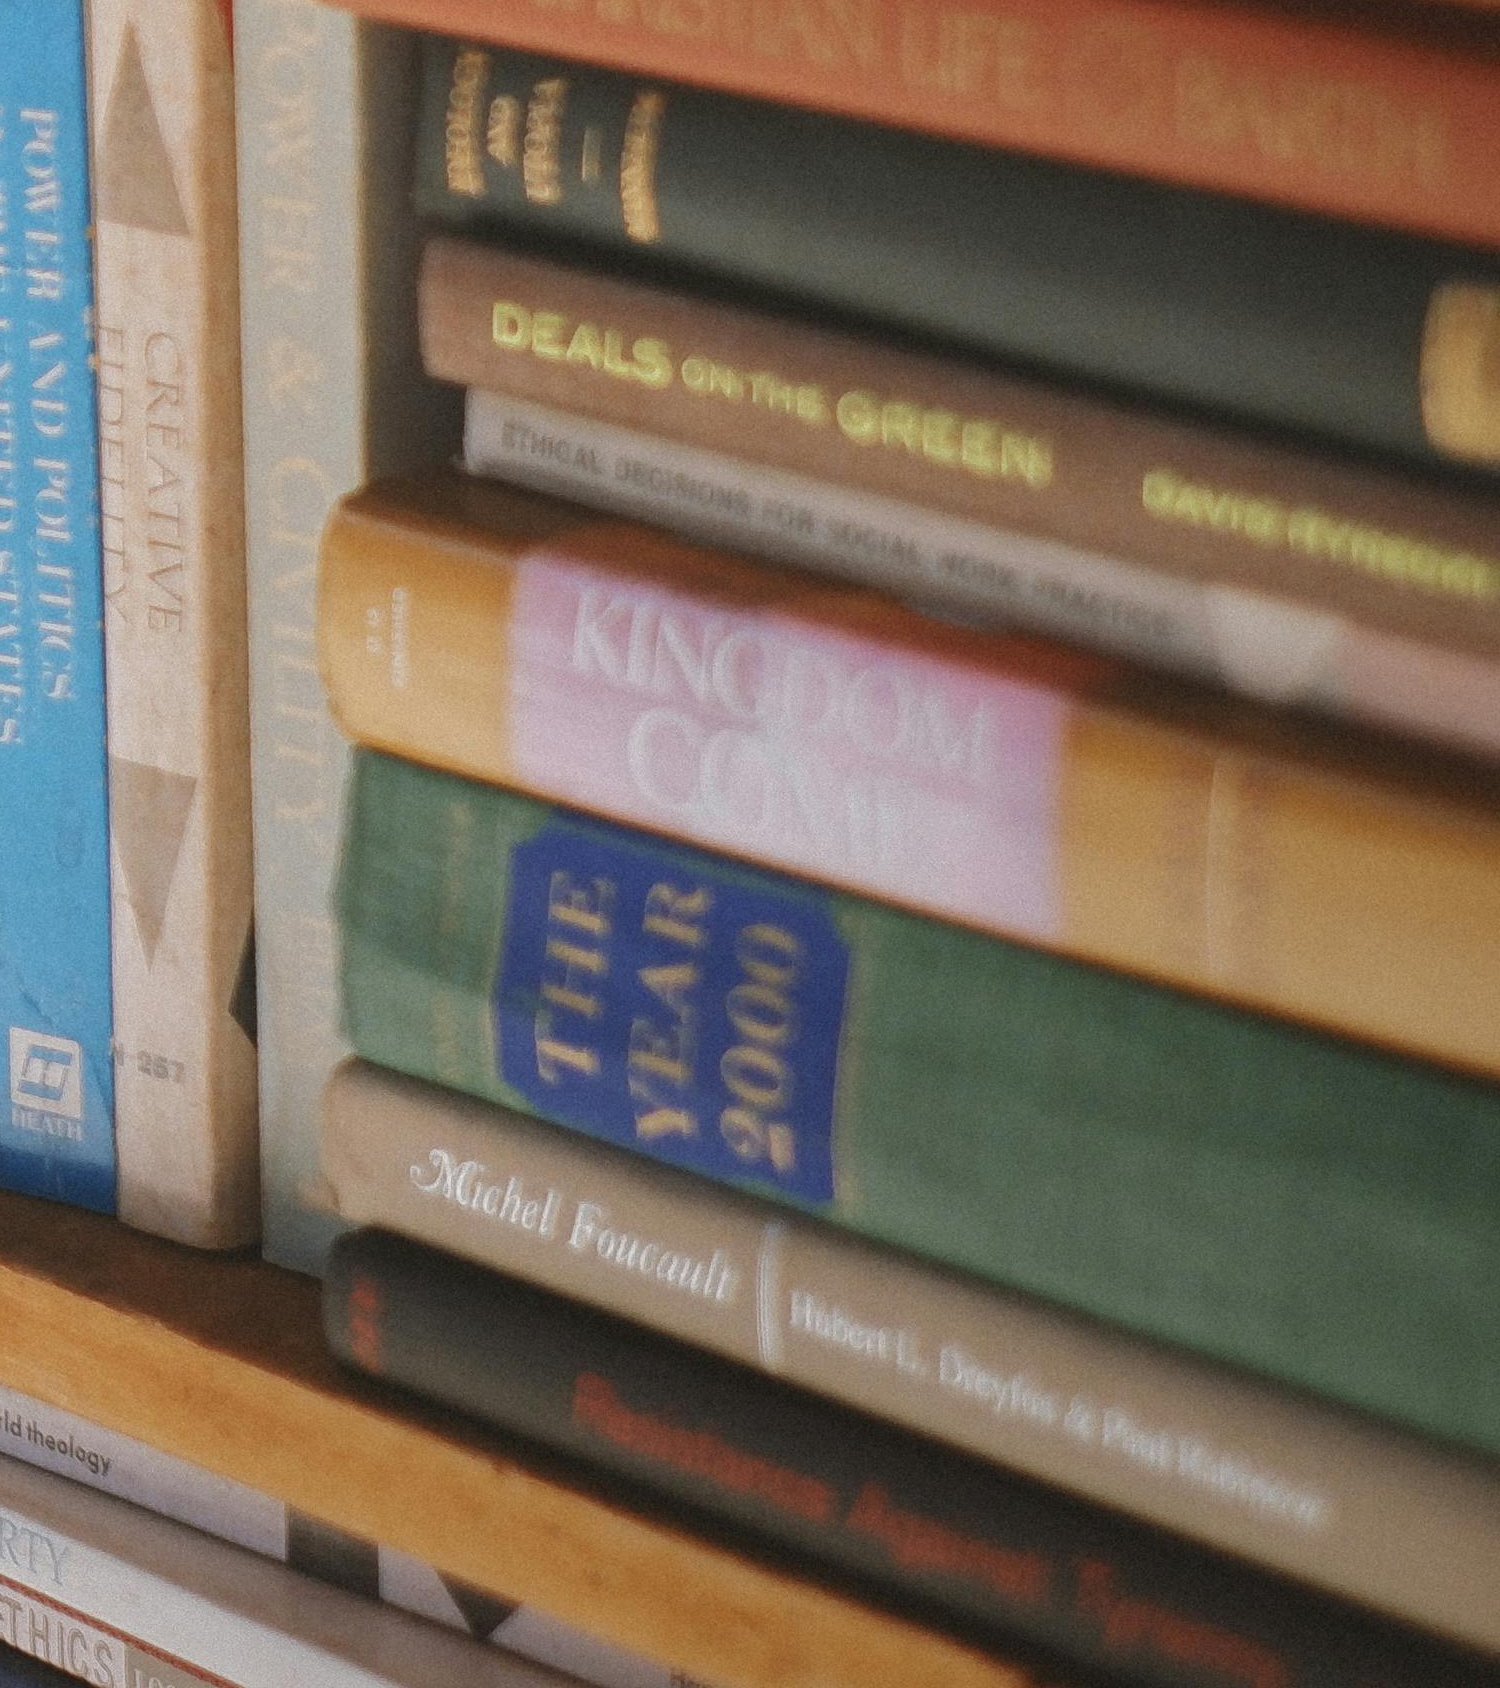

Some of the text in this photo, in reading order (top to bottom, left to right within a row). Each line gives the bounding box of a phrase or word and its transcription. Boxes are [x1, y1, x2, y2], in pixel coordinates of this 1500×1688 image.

[19, 108, 77, 701] POWER AND POLITICS
[99, 324, 129, 627] FIDELITY
[144, 329, 186, 633] CREATIVE
[492, 300, 1055, 488] DEALS ON THE GREEN
[573, 583, 989, 779] KINGDOM
[535, 869, 615, 1085] THE
[627, 881, 715, 1140] YEAR
[720, 922, 799, 1172] 2000
[12, 1109, 85, 1142] HEATH
[410, 1146, 739, 1302] Michel Foucault
[789, 1291, 889, 1354] Hubert
[26, 1415, 112, 1477] theology
